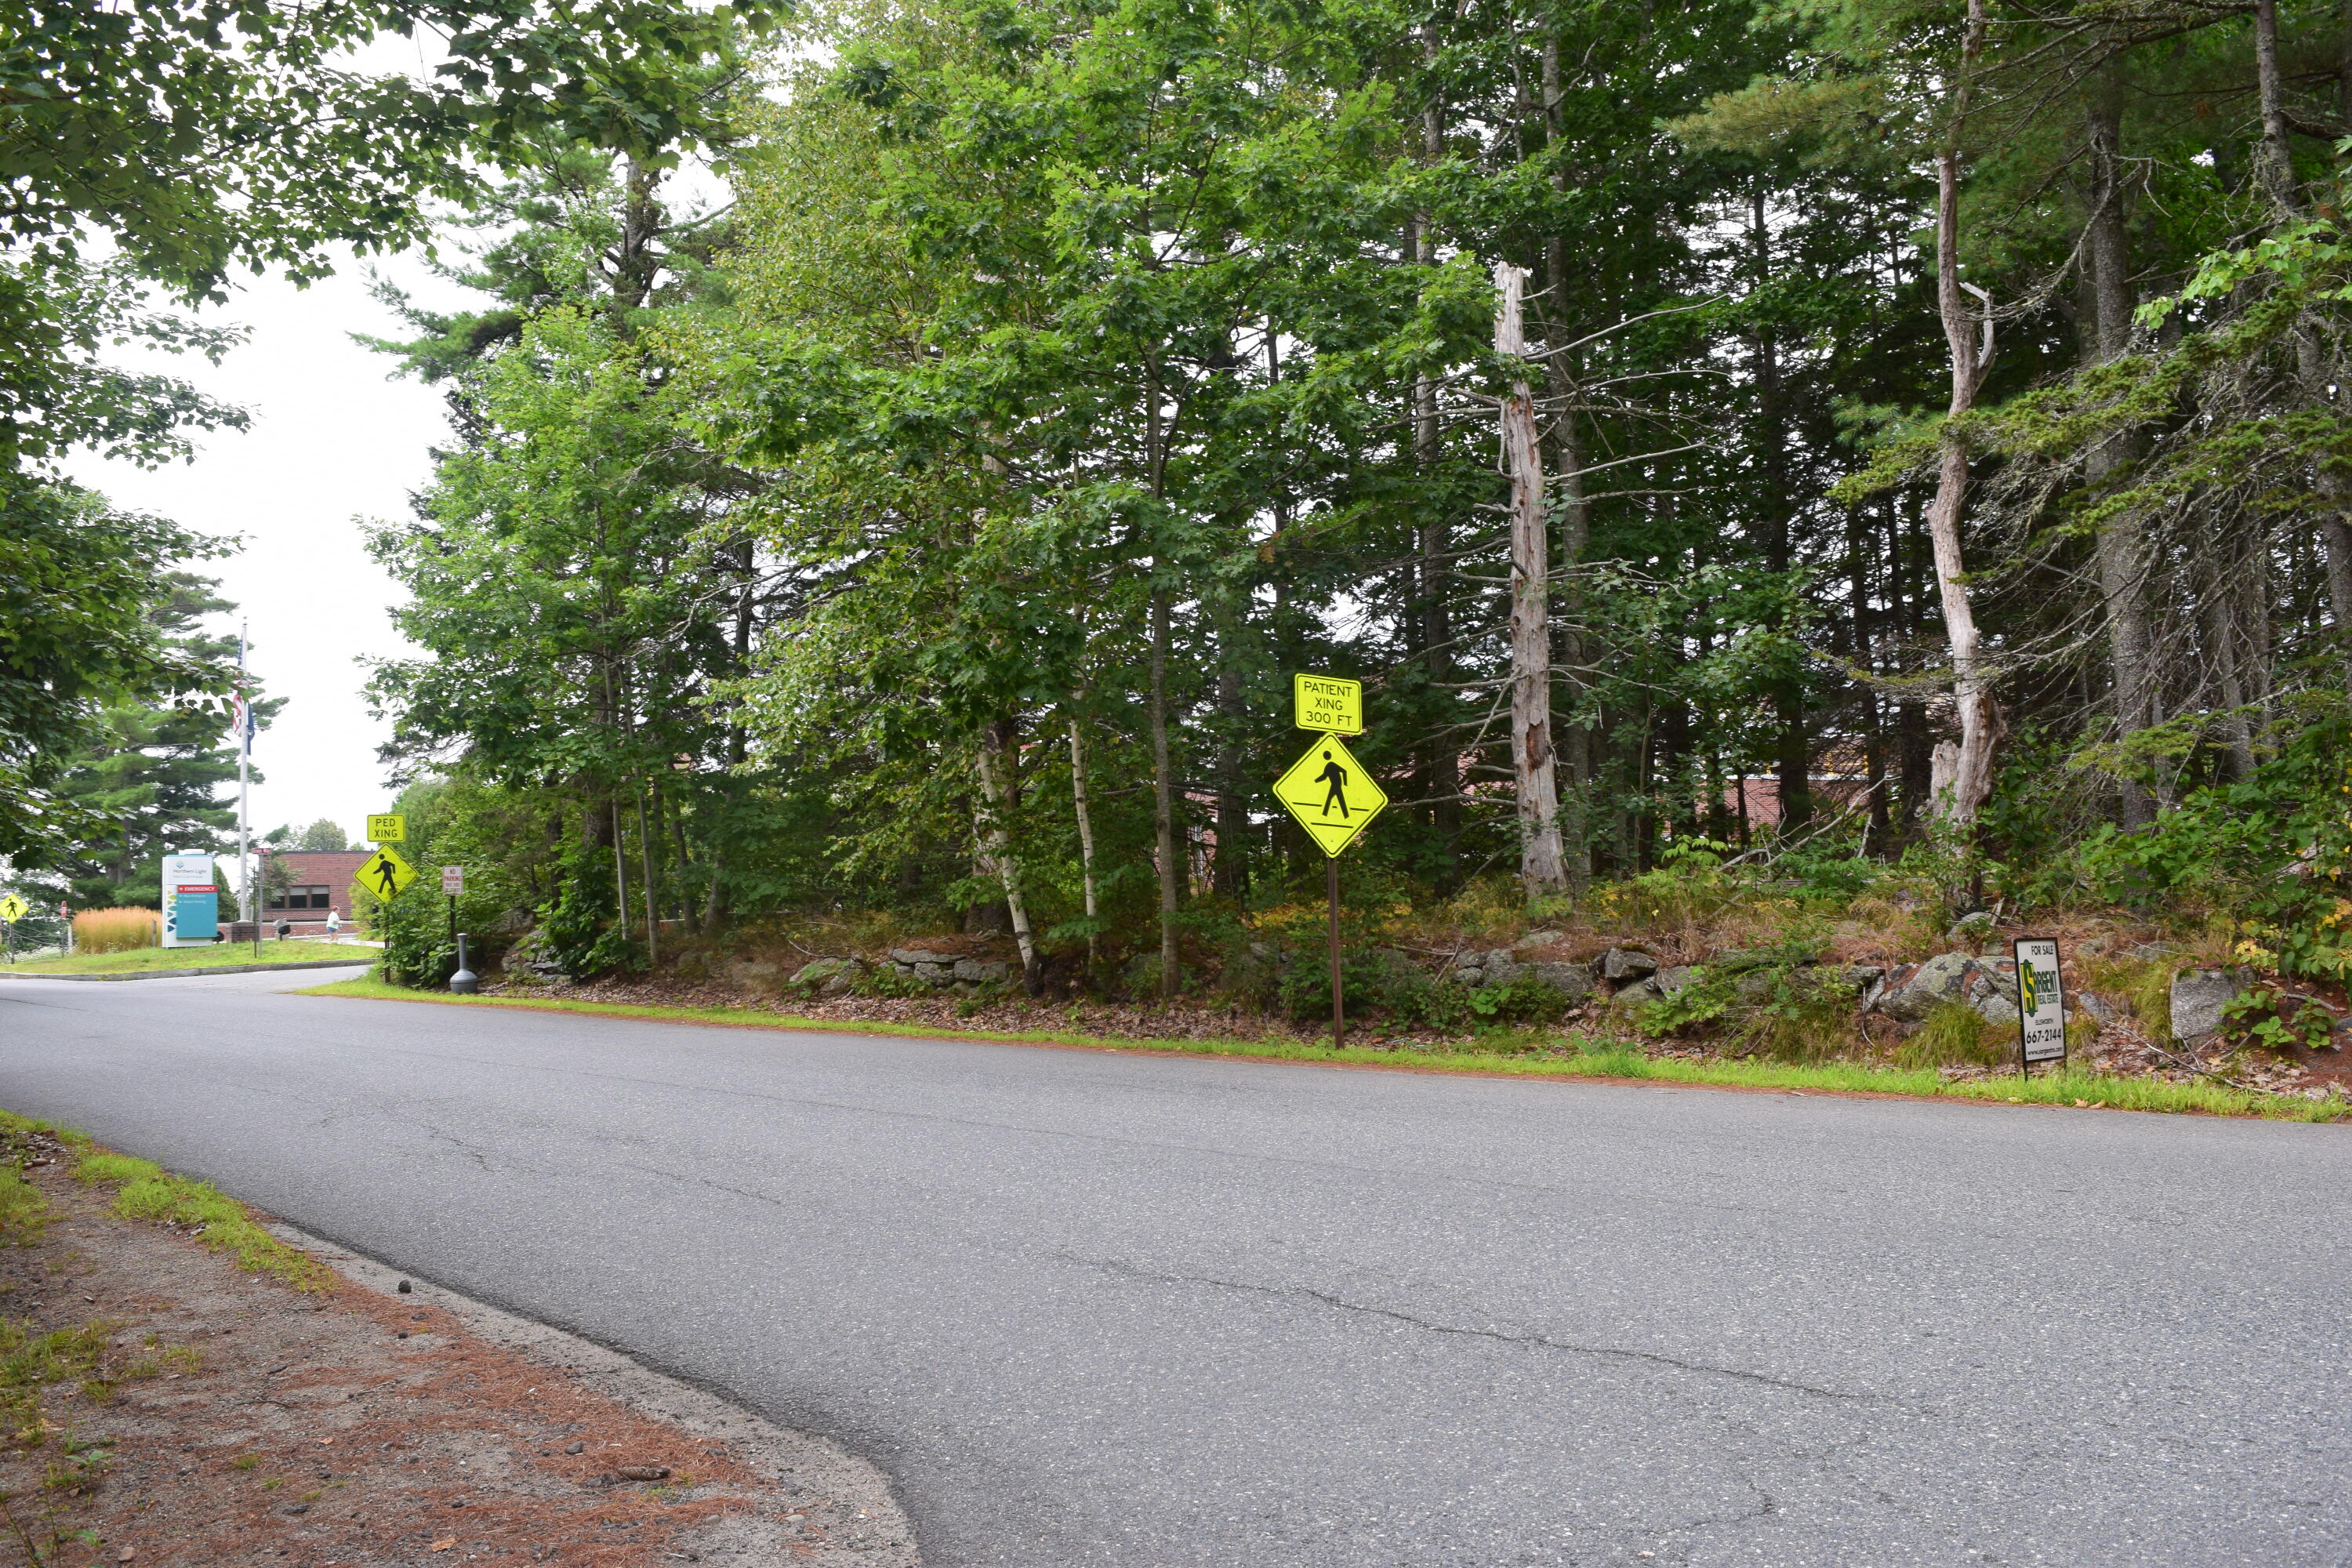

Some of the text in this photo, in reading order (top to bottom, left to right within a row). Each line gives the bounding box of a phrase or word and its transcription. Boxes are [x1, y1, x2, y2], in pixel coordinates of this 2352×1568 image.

[1304, 681, 1352, 697] PATIENT
[1315, 696, 1343, 711] XING
[1305, 710, 1352, 727] 300 FT
[376, 818, 396, 827] PED
[374, 829, 397, 838] XING
[2031, 945, 2054, 956] FOR SALE
[2020, 959, 2058, 1018] SARGENT
[2038, 993, 2059, 1004] REAL ESTATE
[2026, 1028, 2062, 1044] 667-2144
